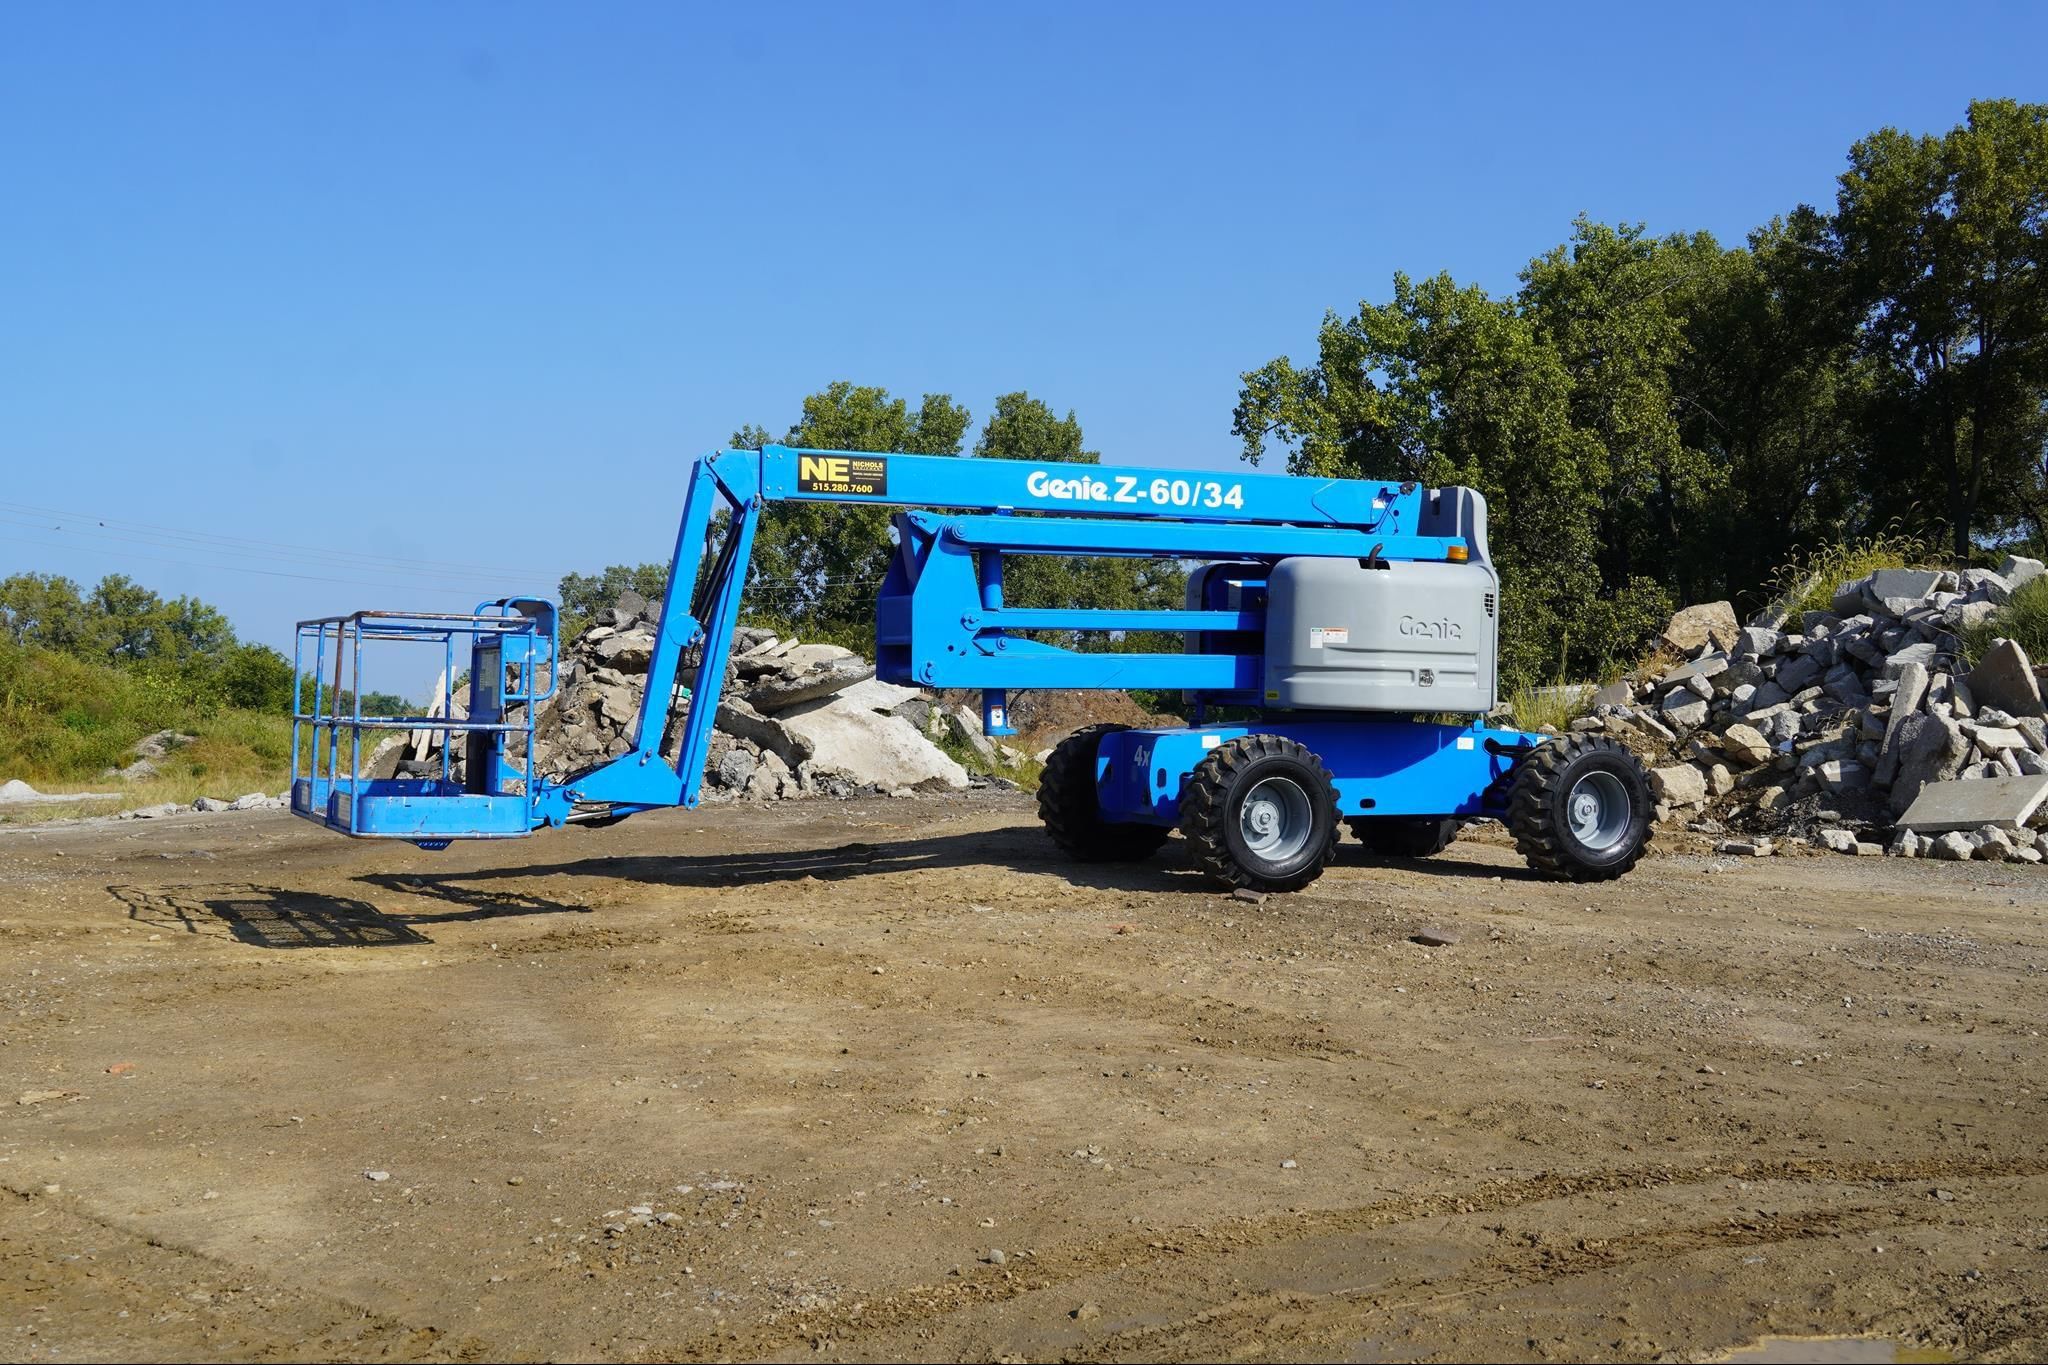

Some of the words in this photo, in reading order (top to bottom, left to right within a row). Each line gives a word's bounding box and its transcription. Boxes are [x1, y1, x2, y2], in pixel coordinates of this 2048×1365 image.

[801, 456, 850, 482] NE
[812, 482, 873, 493] 515.280.7600
[1027, 471, 1110, 501] Genie
[1114, 475, 1244, 509] Z-60/34
[1399, 615, 1462, 640] Genie
